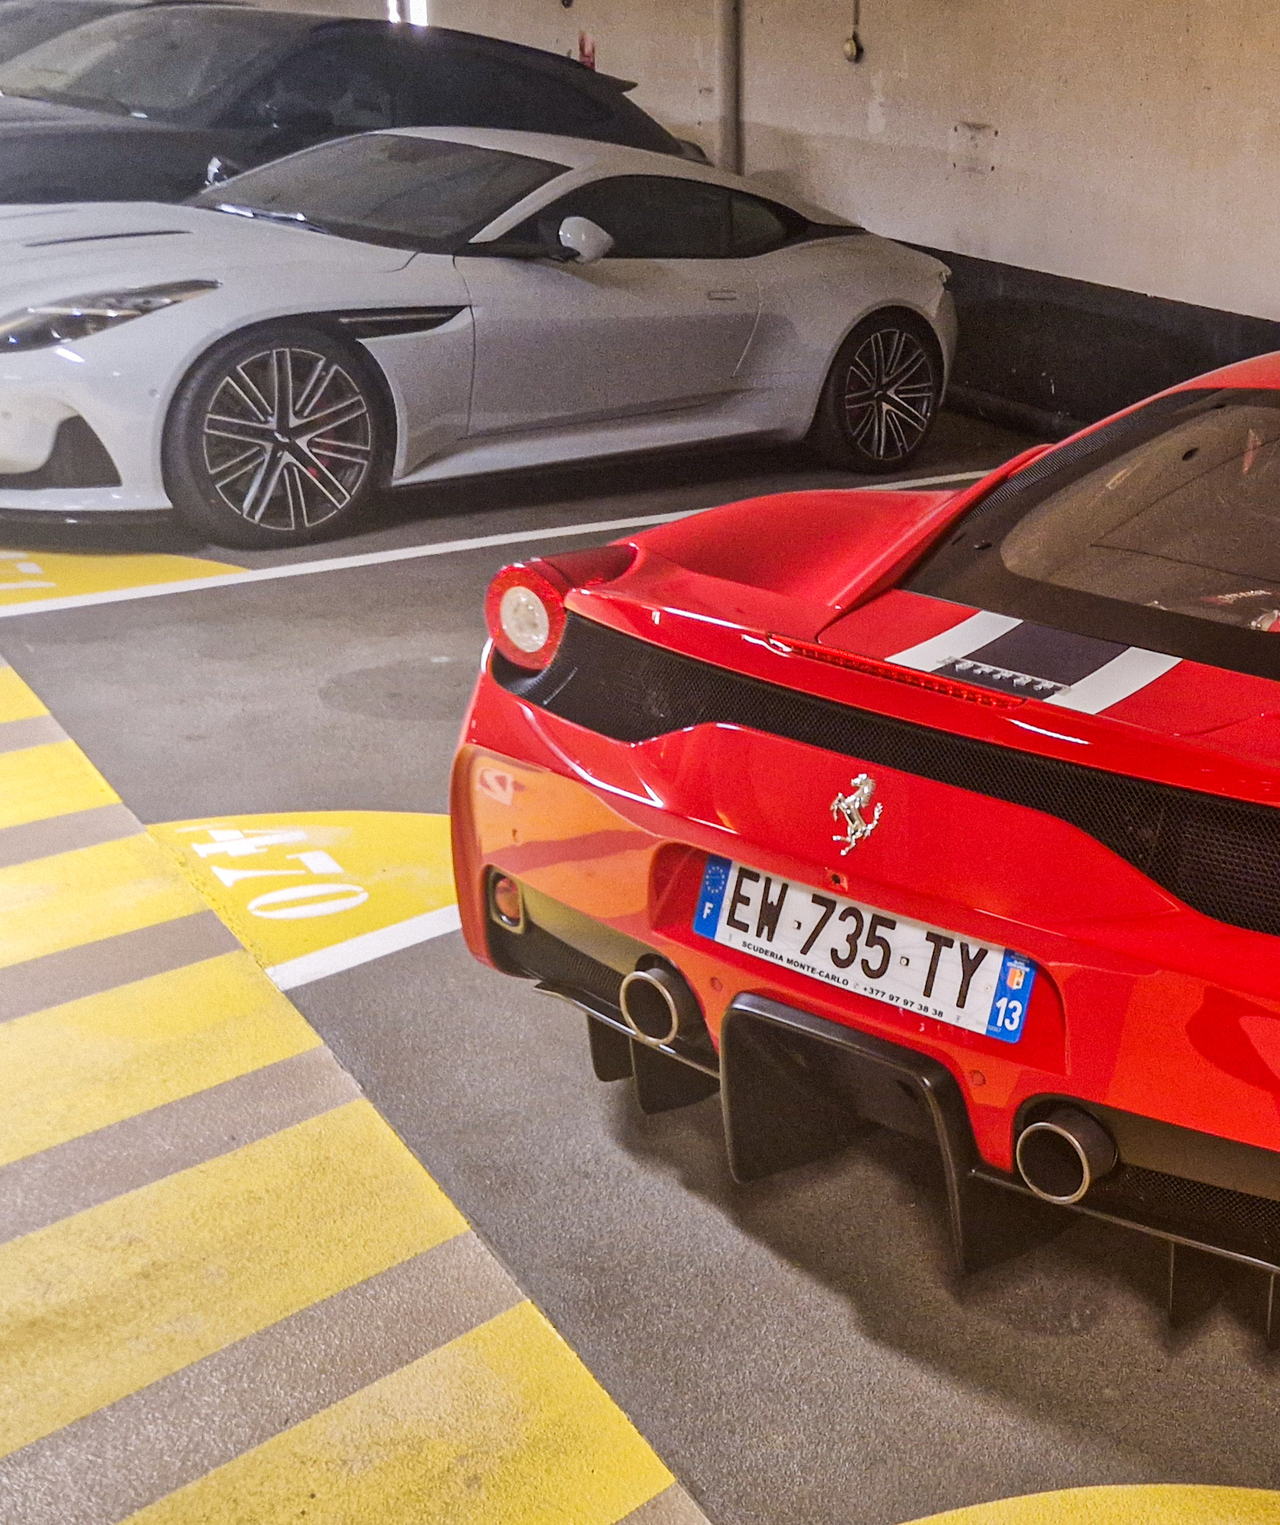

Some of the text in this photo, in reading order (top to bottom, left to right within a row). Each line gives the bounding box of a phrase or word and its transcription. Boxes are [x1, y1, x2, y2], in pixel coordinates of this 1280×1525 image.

[190, 827, 370, 920] 470
[703, 901, 714, 919] F
[726, 866, 989, 1009] EW 735 TY
[742, 940, 944, 1018] SCUDERIA MONTE-CARLO +377 97 97 38 38
[996, 997, 1023, 1031] 13
